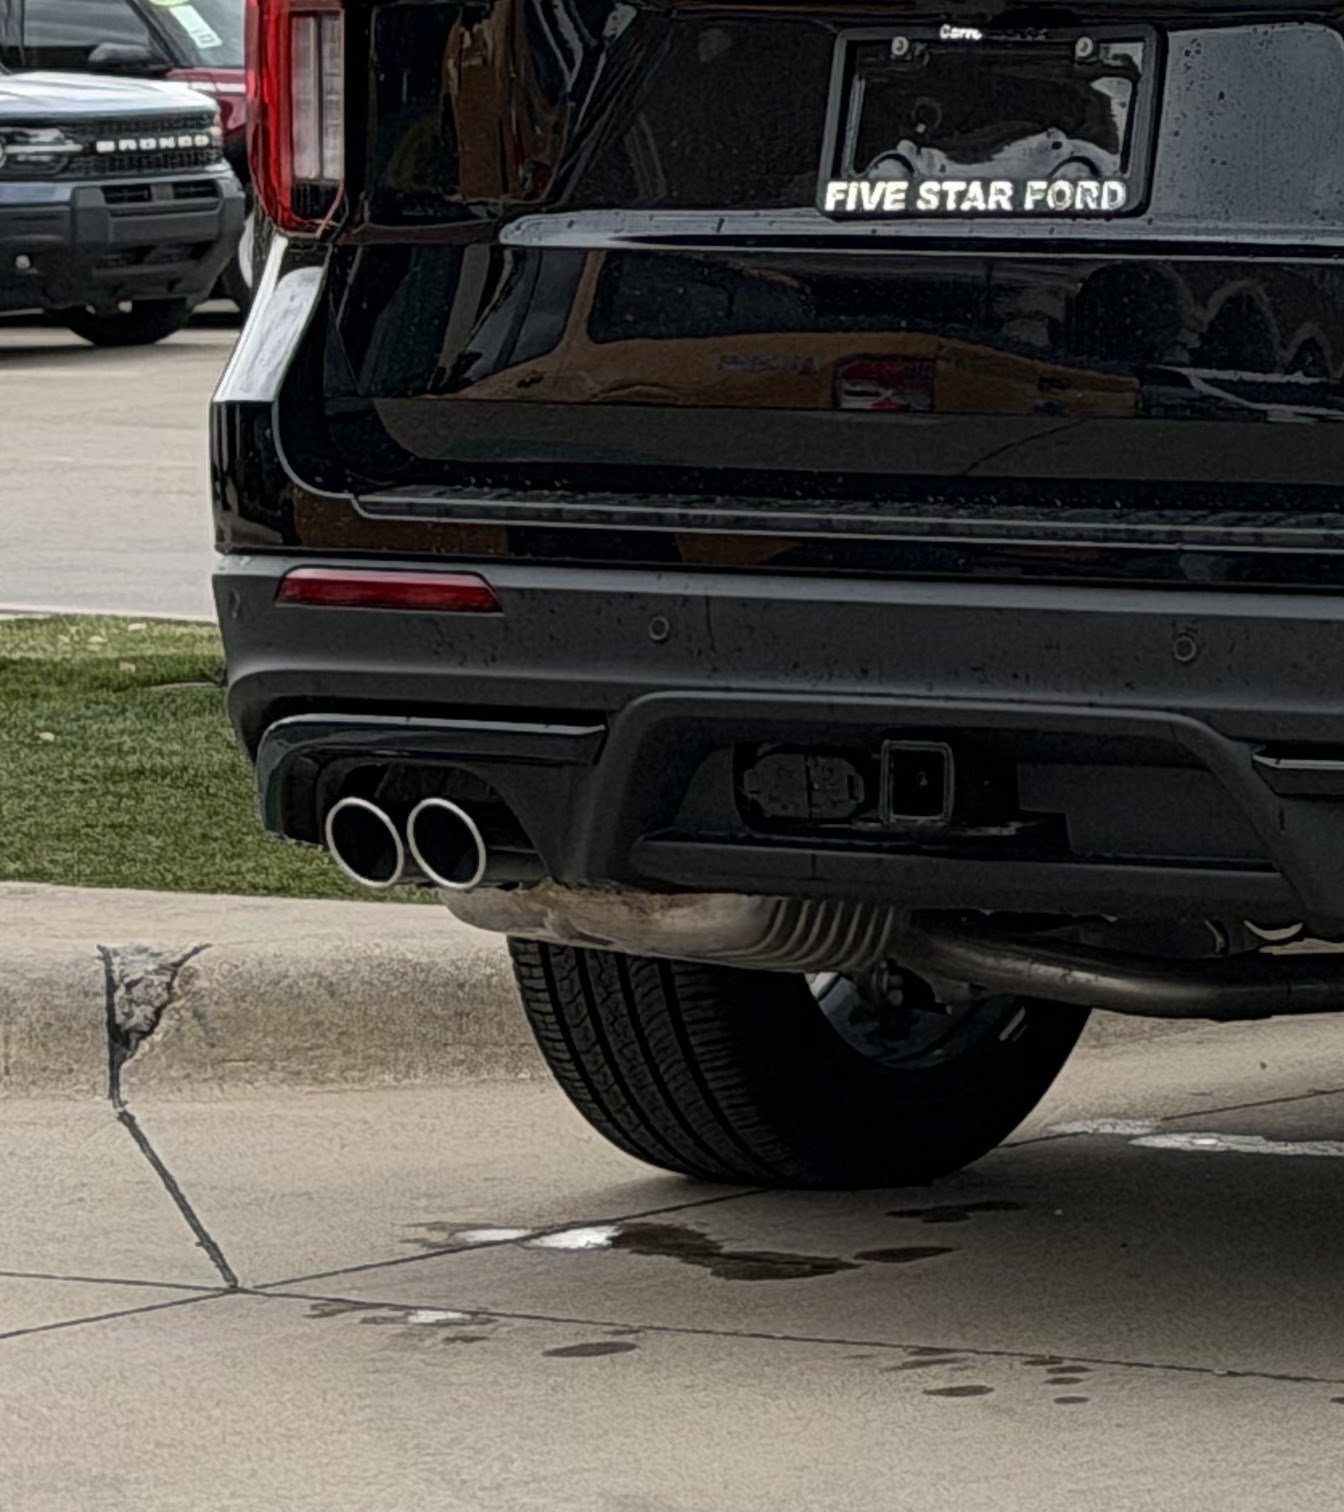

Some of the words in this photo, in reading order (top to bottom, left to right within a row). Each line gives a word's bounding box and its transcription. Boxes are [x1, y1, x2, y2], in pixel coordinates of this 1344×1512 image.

[823, 181, 909, 212] FIVE
[916, 180, 1014, 211] STAR
[1023, 179, 1129, 211] FORD
